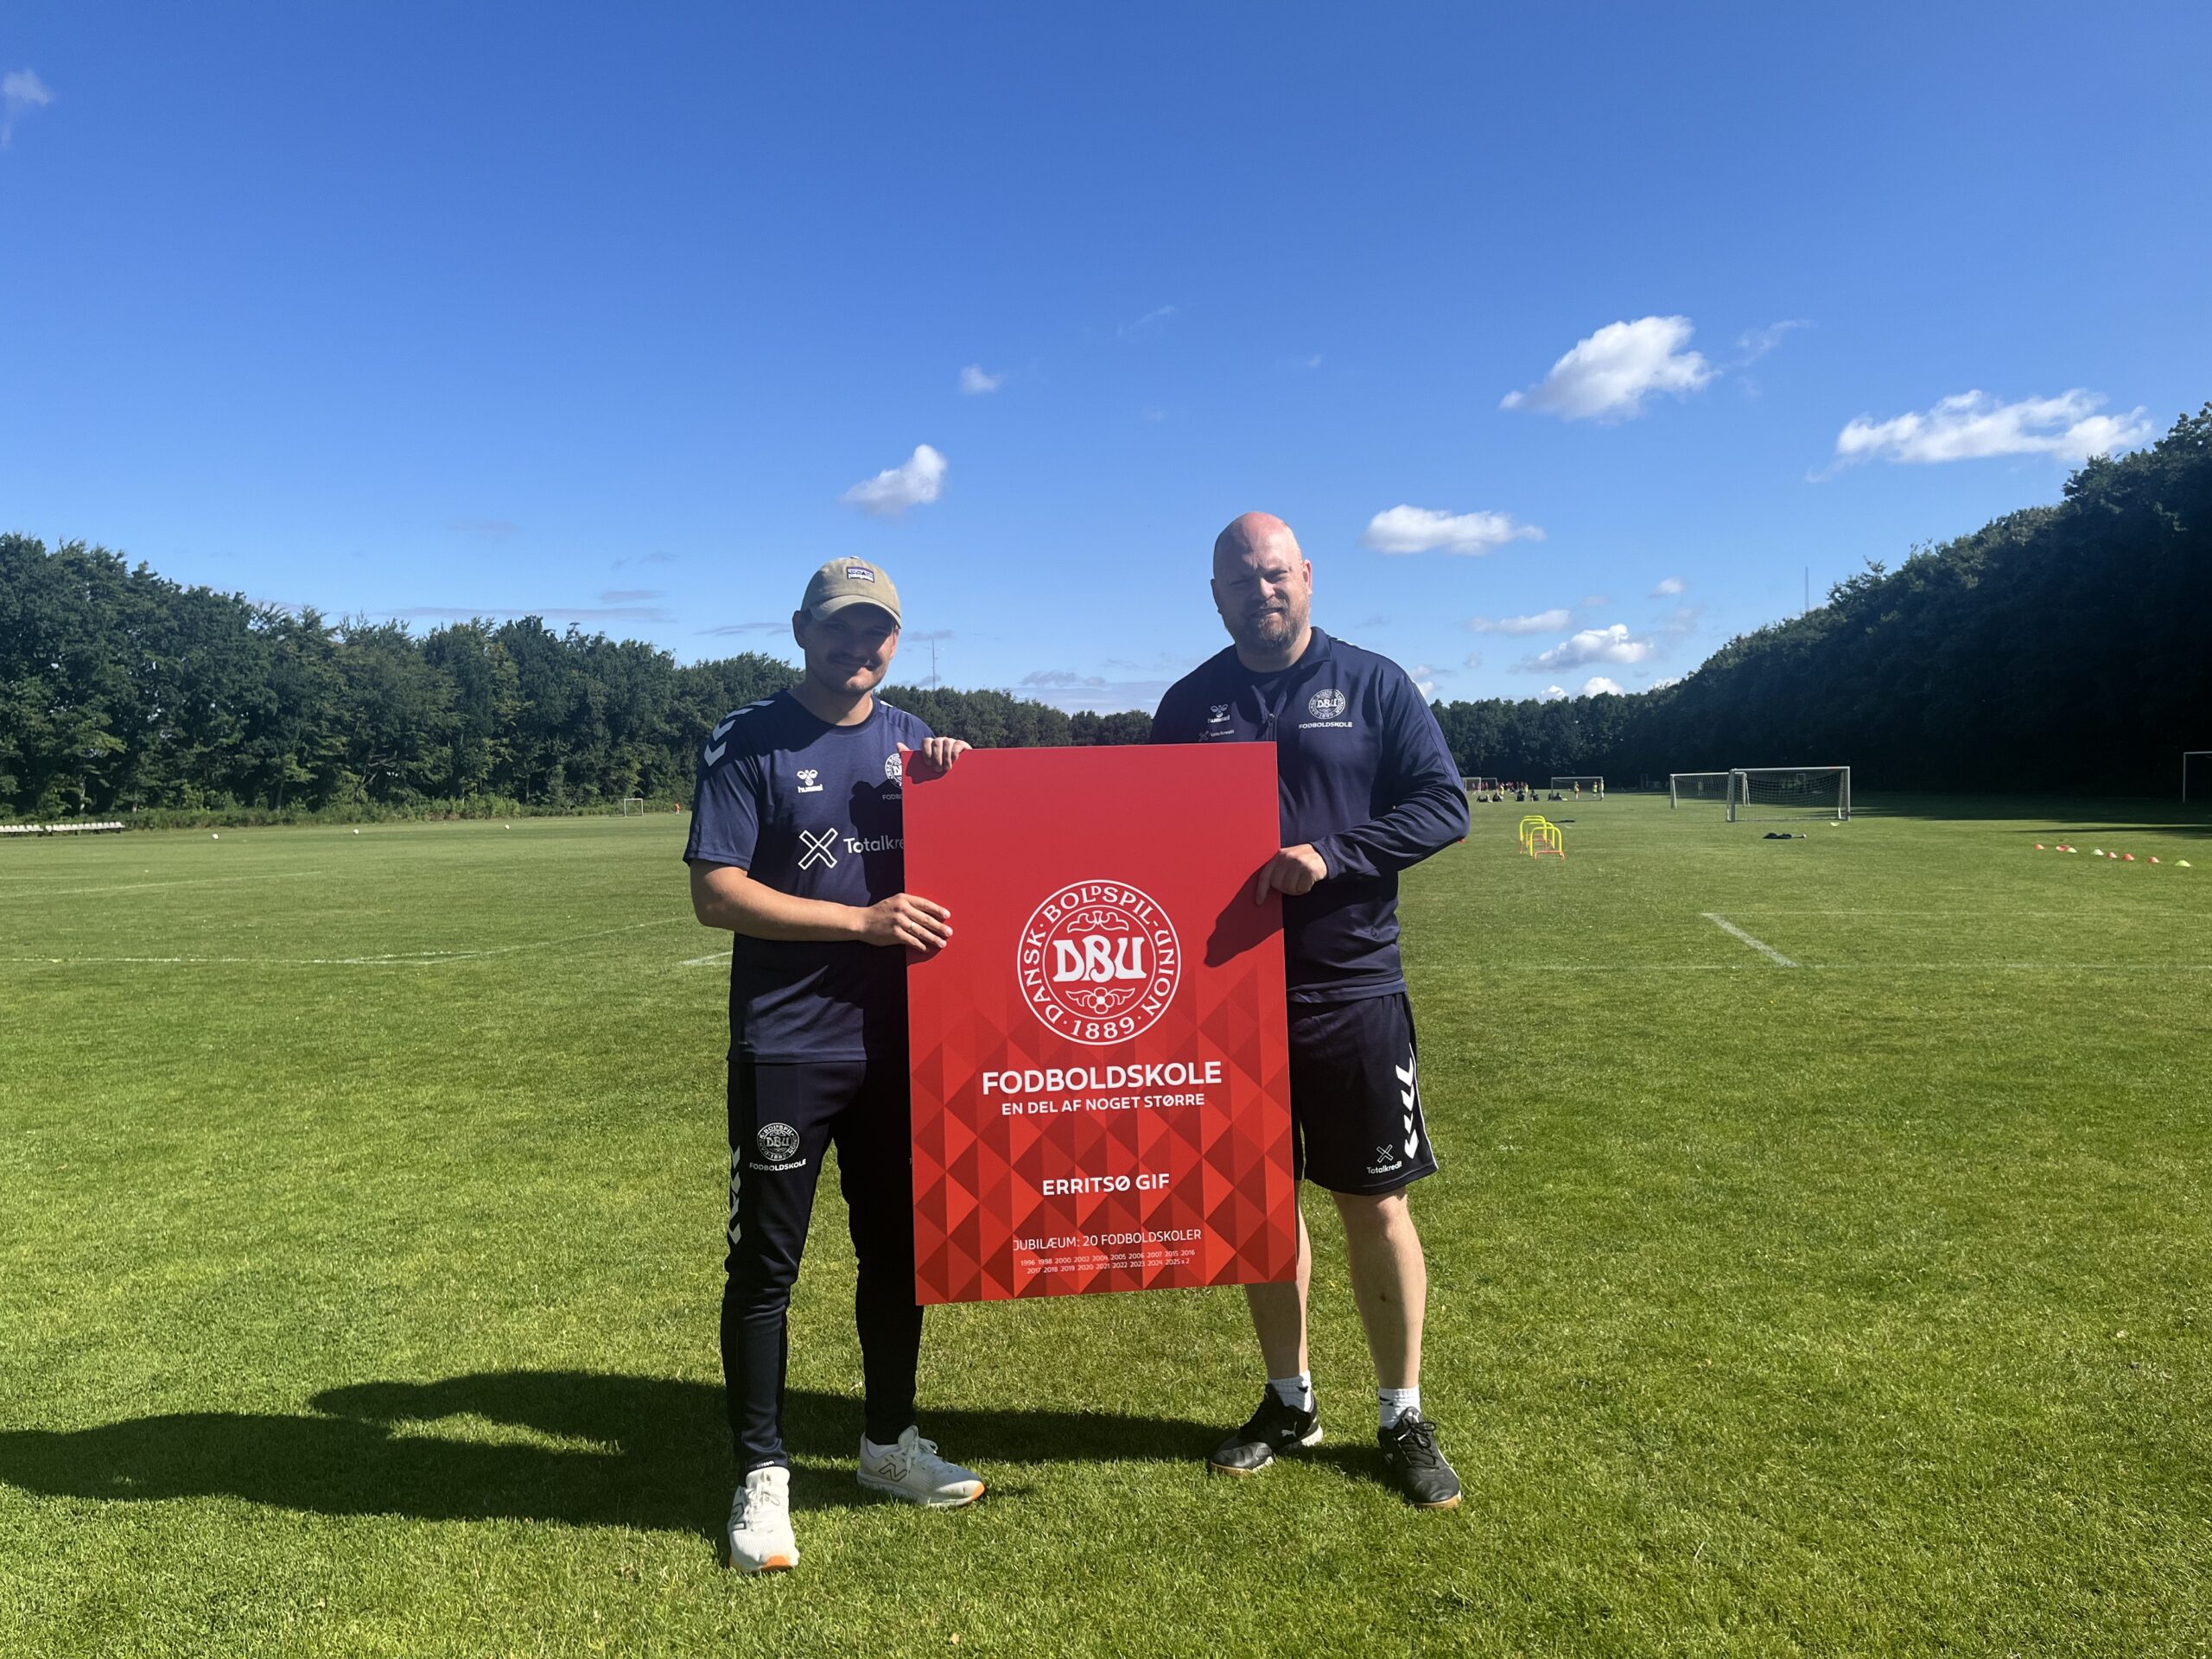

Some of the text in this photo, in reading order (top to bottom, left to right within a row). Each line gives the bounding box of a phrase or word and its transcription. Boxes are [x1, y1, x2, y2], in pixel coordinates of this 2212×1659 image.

[1052, 934, 1147, 983] DBU
[1023, 927, 1065, 1025] DANSK
[1071, 1016, 1135, 1040] 1889
[982, 1061, 1222, 1095] FODBOLDSKOLE
[1001, 1093, 1205, 1116] EN DEL AF NOGET STØRRE
[766, 1136, 790, 1147] DBU
[749, 1158, 807, 1172] FODBOLDSKOLE
[1042, 1173, 1170, 1196] ERRITSØ GIF
[1014, 1230, 1202, 1251] JUBILÆUM: 20 FODBOLDSKOLER
